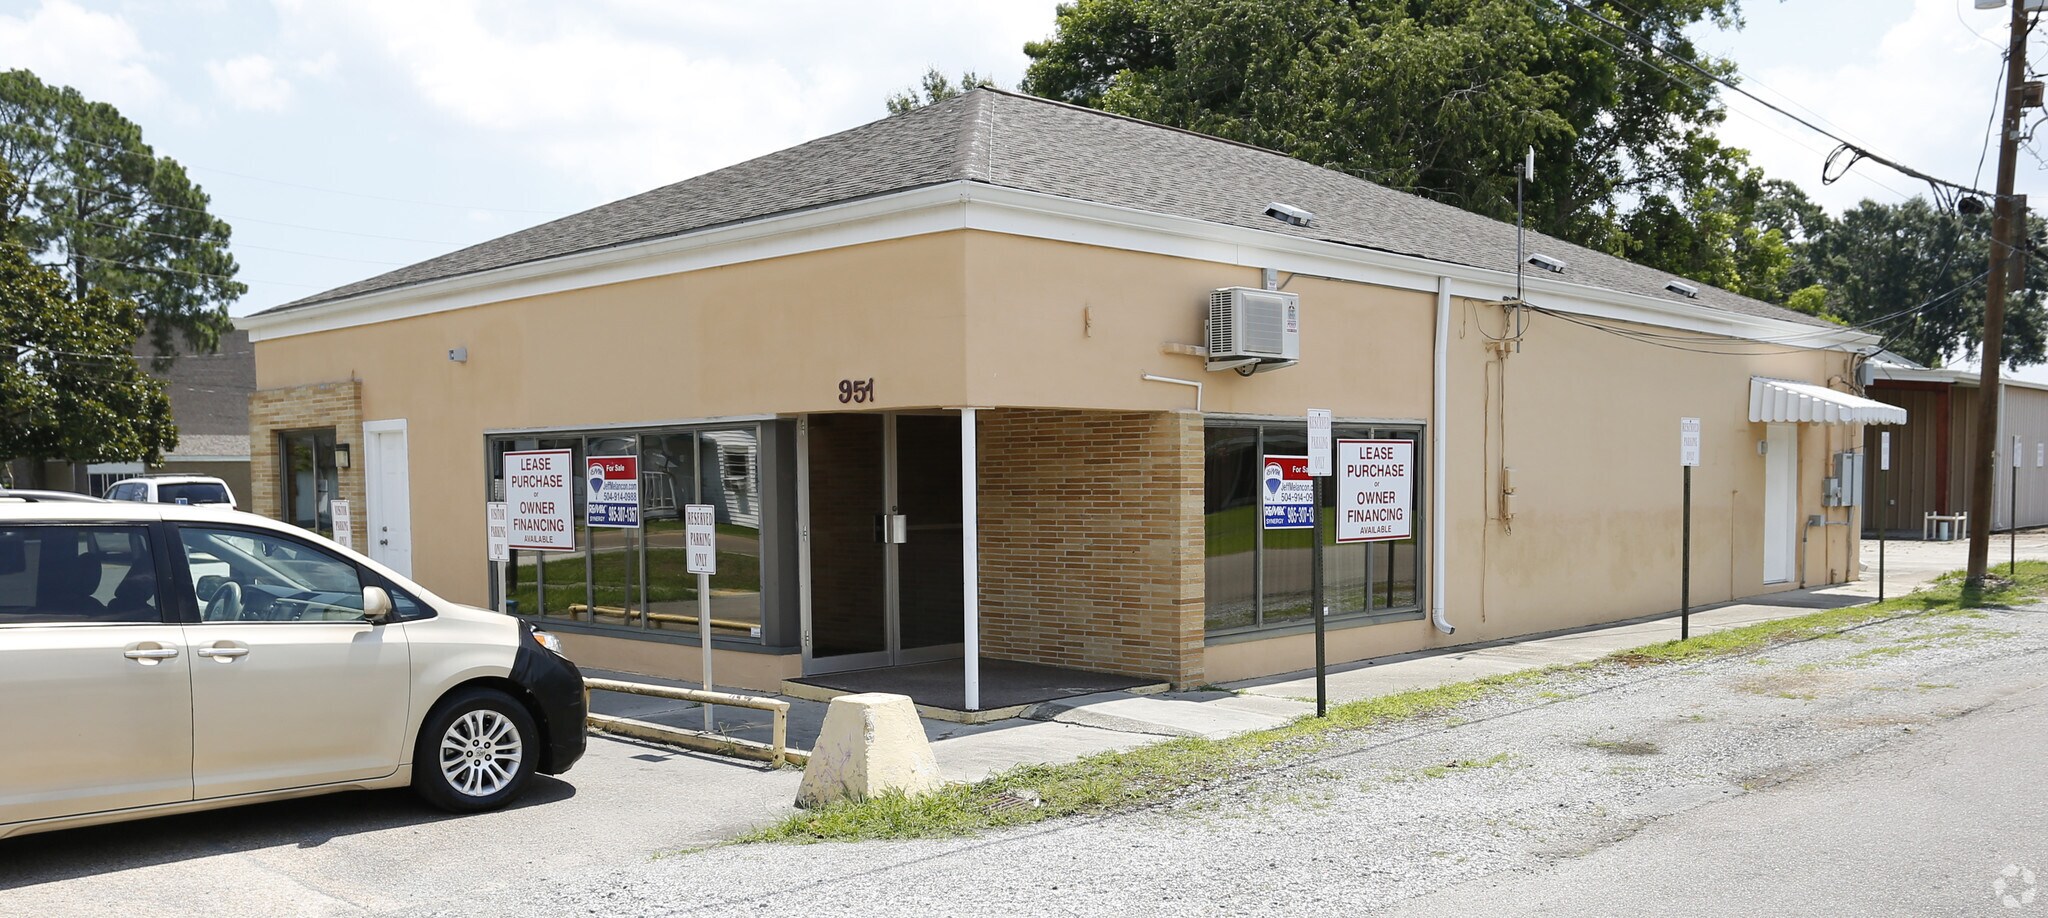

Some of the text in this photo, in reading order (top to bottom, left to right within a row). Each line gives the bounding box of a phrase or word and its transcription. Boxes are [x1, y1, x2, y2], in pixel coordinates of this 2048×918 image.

[839, 378, 874, 403] 951
[1359, 447, 1394, 460] LEASE
[520, 457, 551, 471] LEASE
[606, 464, 625, 472] For Sale
[1292, 465, 1301, 473] For
[1347, 464, 1404, 478] PURCHASE
[511, 474, 563, 488] PURCHASE
[1281, 482, 1313, 492] JeffMelancon.c
[1281, 492, 1313, 502] 504-914-09
[1356, 491, 1396, 505] OWNER
[519, 501, 555, 515] OWNER
[688, 512, 713, 525] RESERVED
[1347, 508, 1403, 523] FINANCING
[513, 518, 565, 532] FINANCING
[1360, 525, 1392, 535] AVAILABLE
[523, 535, 554, 544] AVAILABLE
[690, 532, 711, 547] PARKING
[696, 553, 707, 567] ONLY
